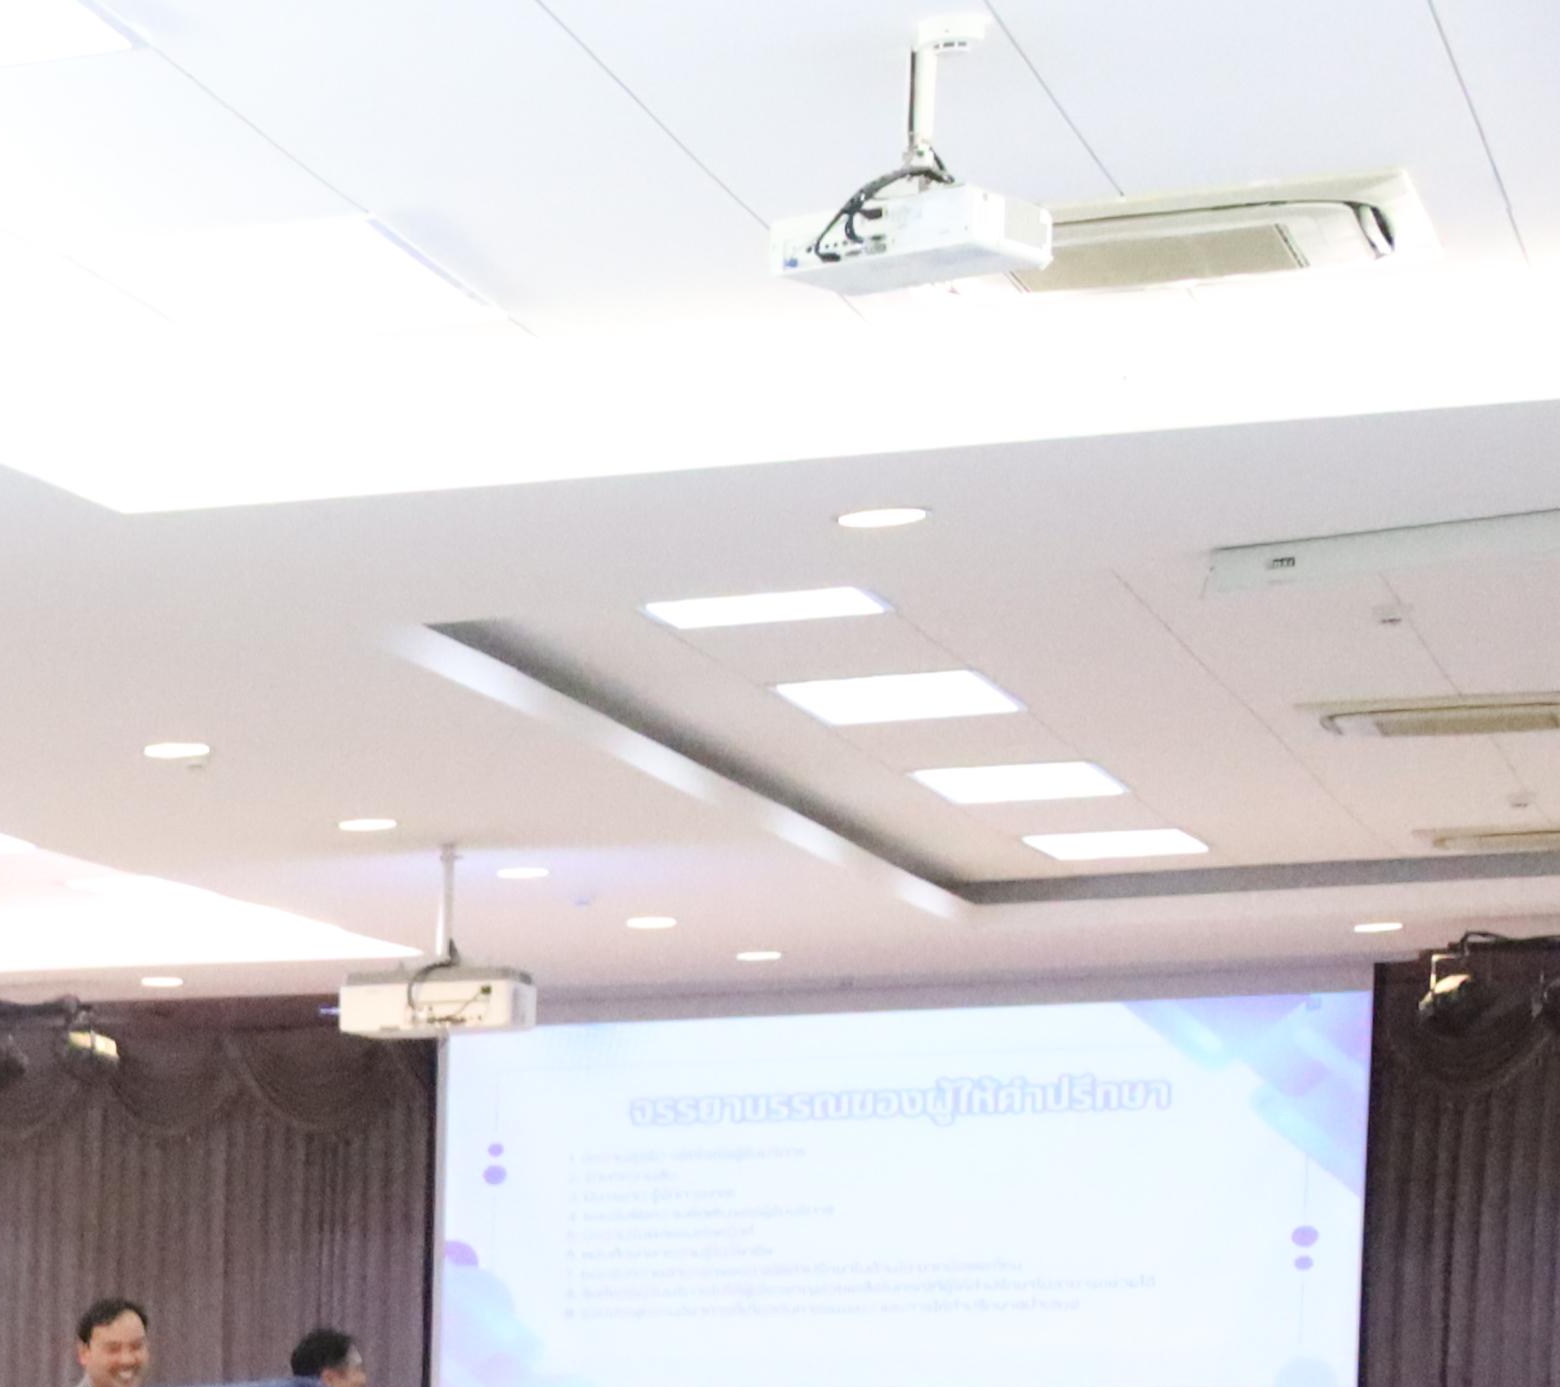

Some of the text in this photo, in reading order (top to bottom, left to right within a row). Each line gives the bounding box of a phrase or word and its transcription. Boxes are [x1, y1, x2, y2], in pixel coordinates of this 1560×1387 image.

[629, 1074, 1172, 1127] จรรยาบรรณของผู้ให้คำปรึกษา
